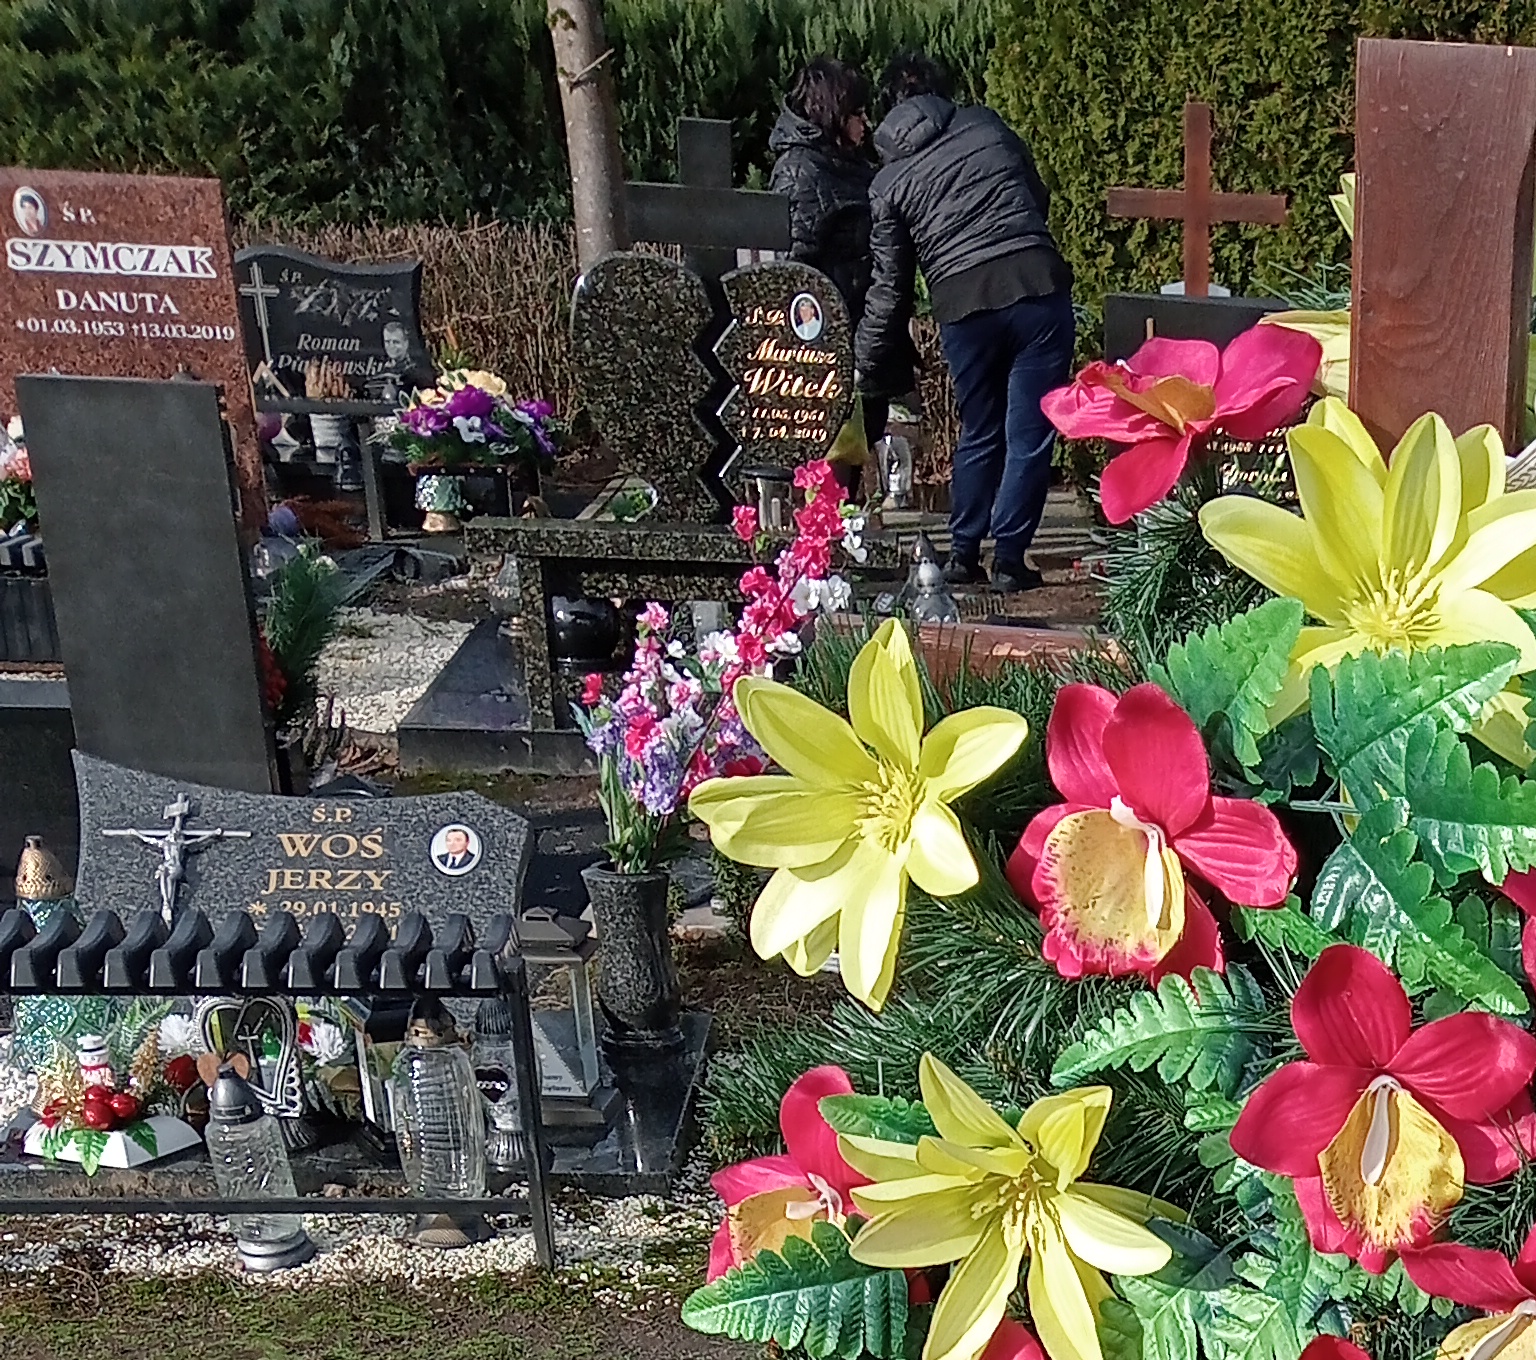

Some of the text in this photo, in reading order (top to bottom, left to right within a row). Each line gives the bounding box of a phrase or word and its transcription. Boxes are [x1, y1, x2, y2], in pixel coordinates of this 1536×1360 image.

[9, 240, 213, 275] SZYMCZAK
[56, 288, 180, 315] DANUTA
[297, 333, 361, 351] Roman
[746, 337, 838, 364] Mariusz
[743, 366, 844, 399] Witek
[276, 827, 385, 859] WOŚ
[260, 868, 394, 895] JERZY
